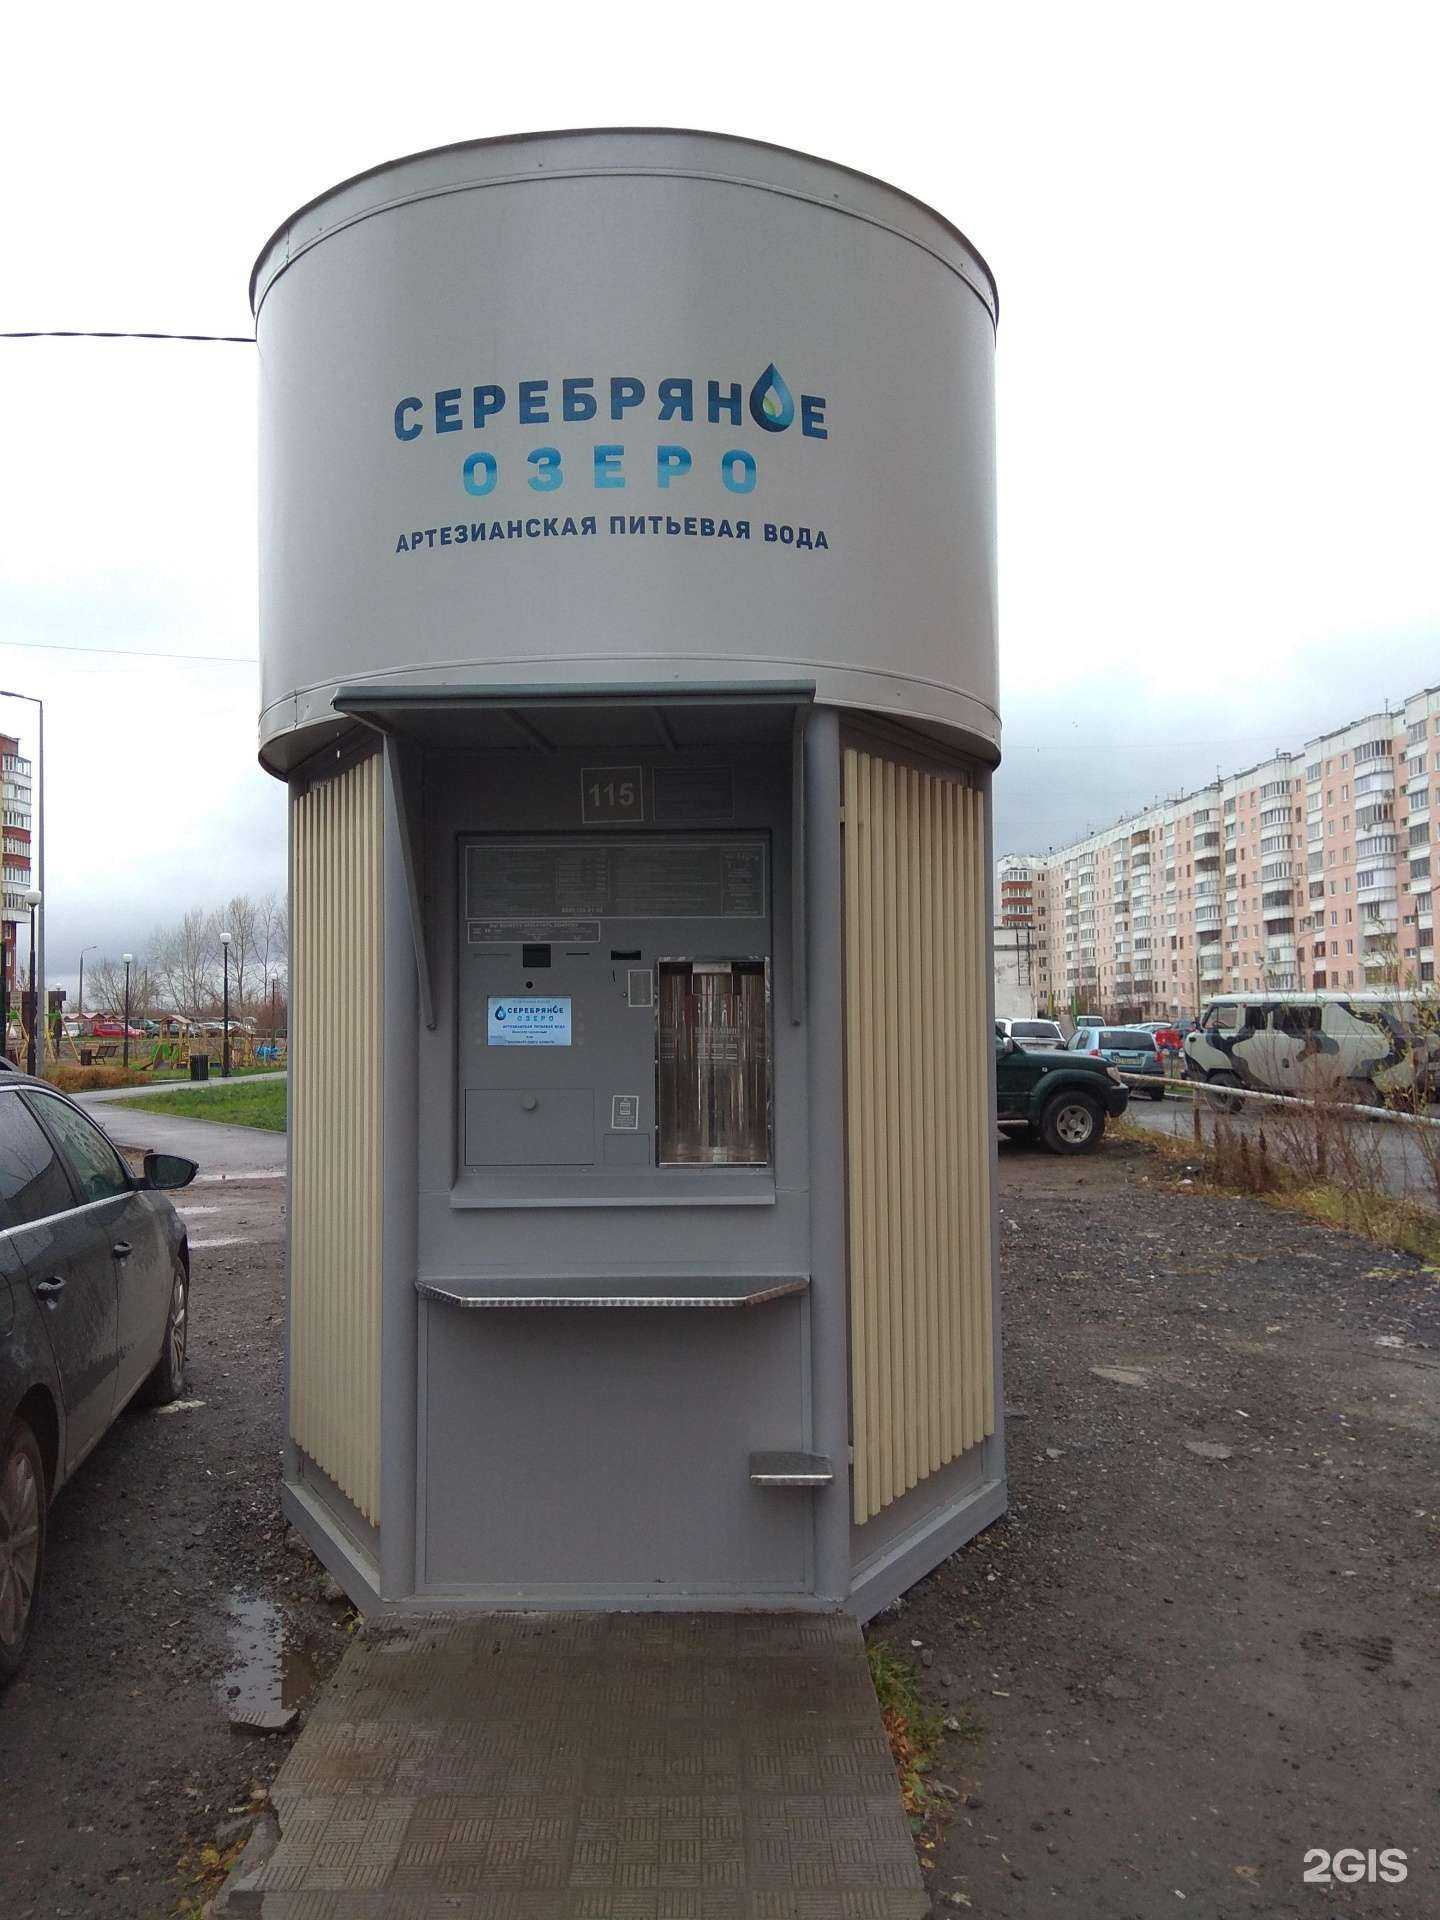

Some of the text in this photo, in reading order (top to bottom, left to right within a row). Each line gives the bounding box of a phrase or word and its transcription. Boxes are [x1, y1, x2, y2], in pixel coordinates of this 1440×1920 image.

[394, 363, 829, 441] СЕРЕБРЯНОЕ
[462, 444, 757, 496] ОЗЕРО
[395, 515, 829, 553] АРТЕЗИАНСКАЯ ПИТЬЕВАЯ ВОДА
[588, 782, 635, 807] 115
